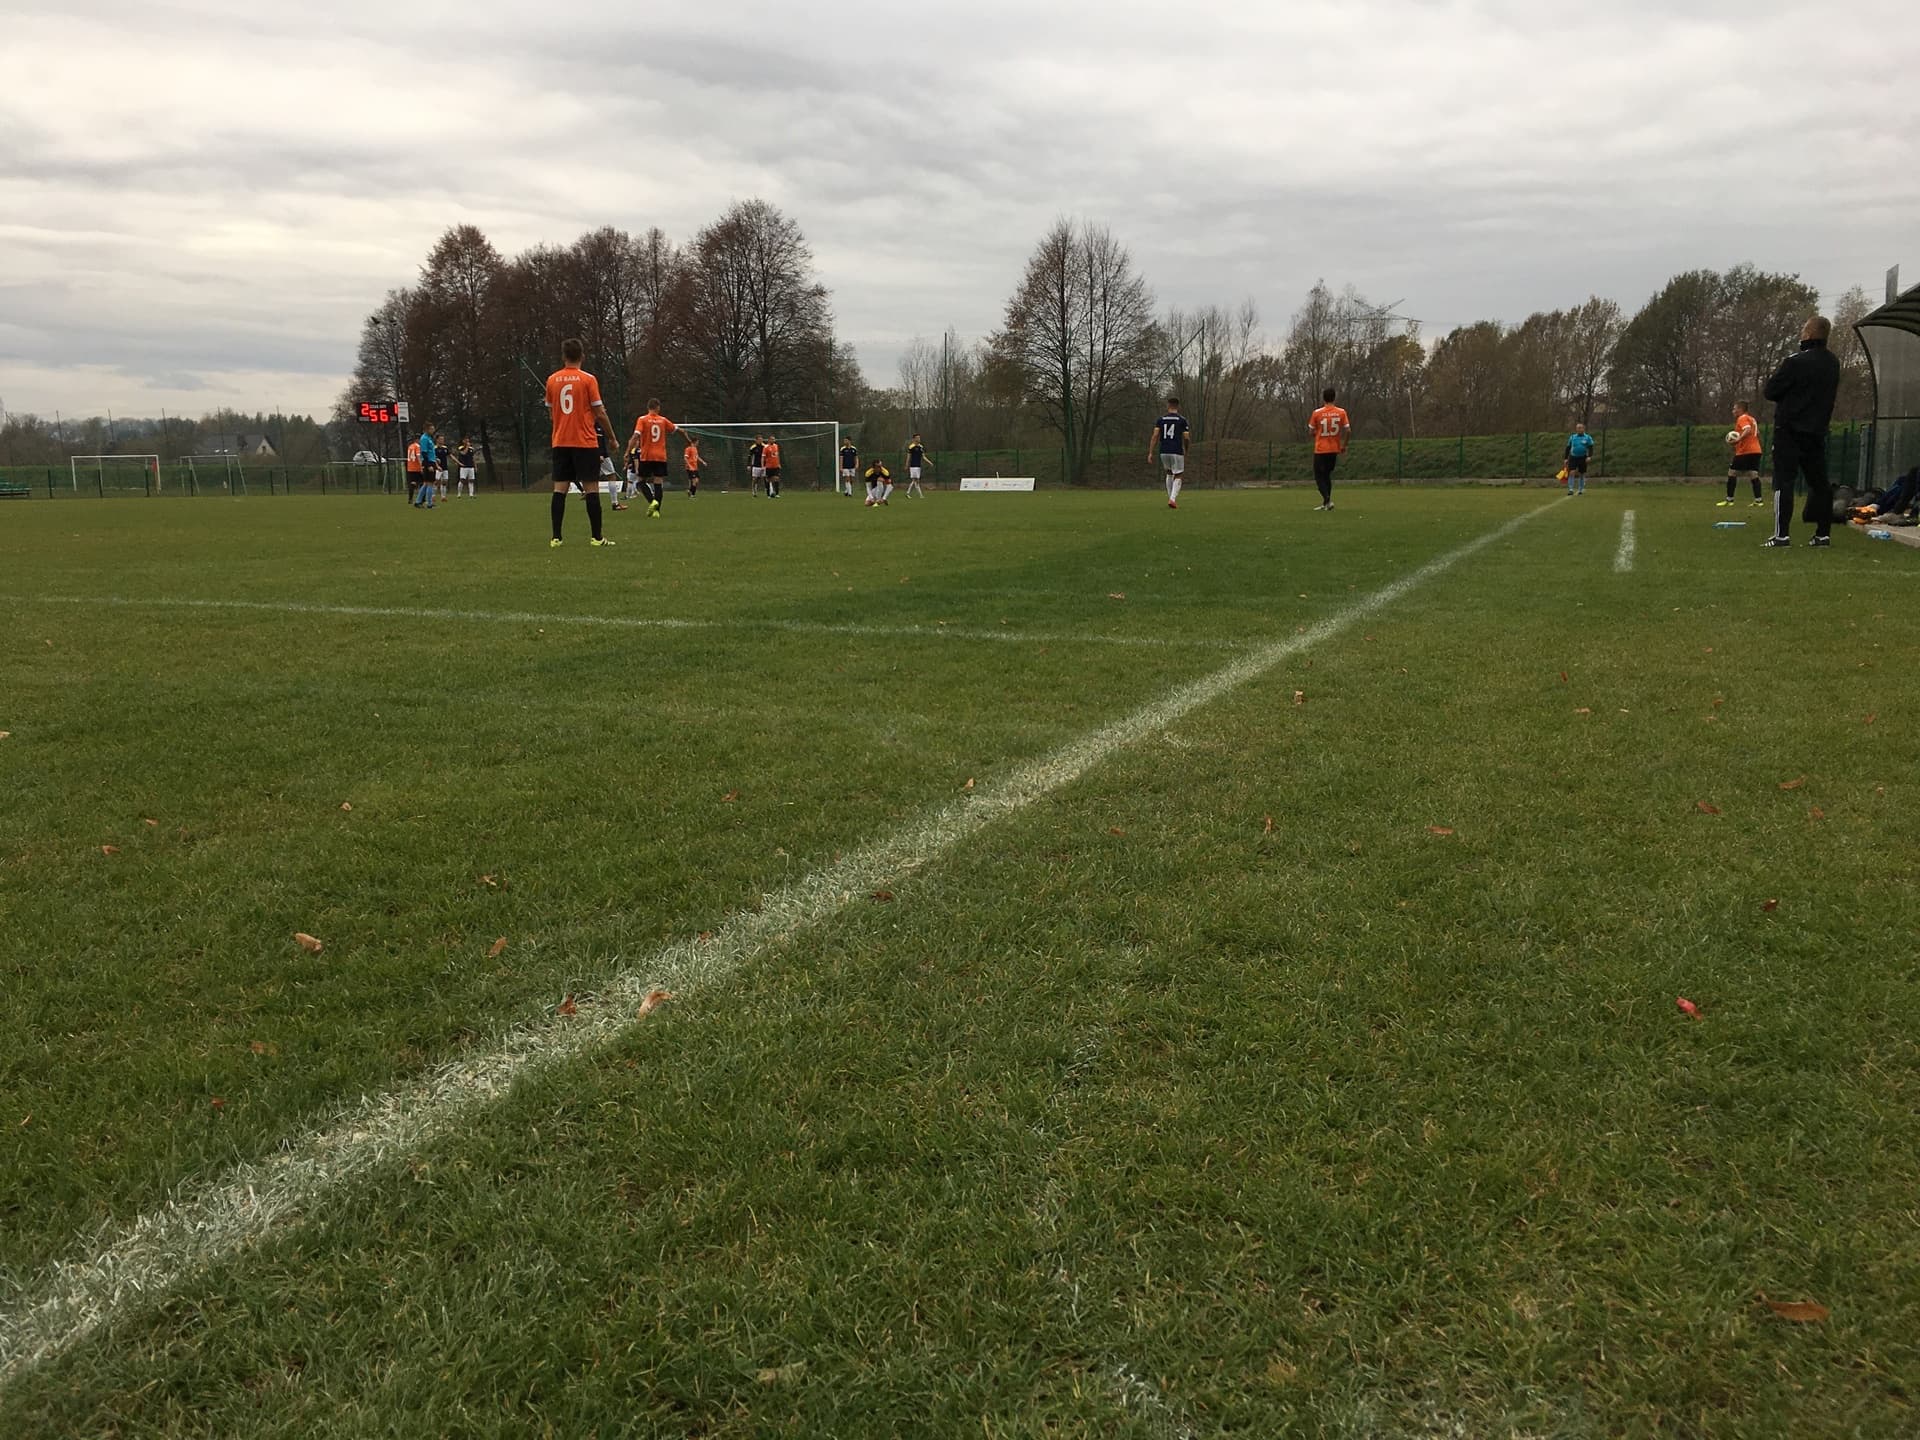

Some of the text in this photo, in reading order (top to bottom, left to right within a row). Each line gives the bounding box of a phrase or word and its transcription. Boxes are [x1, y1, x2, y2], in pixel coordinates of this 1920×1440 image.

[560, 384, 573, 415] 6
[361, 403, 369, 415] 2
[370, 410, 388, 421] 56
[651, 424, 660, 442] 9
[1163, 423, 1175, 439] 14
[1320, 418, 1340, 436] 15
